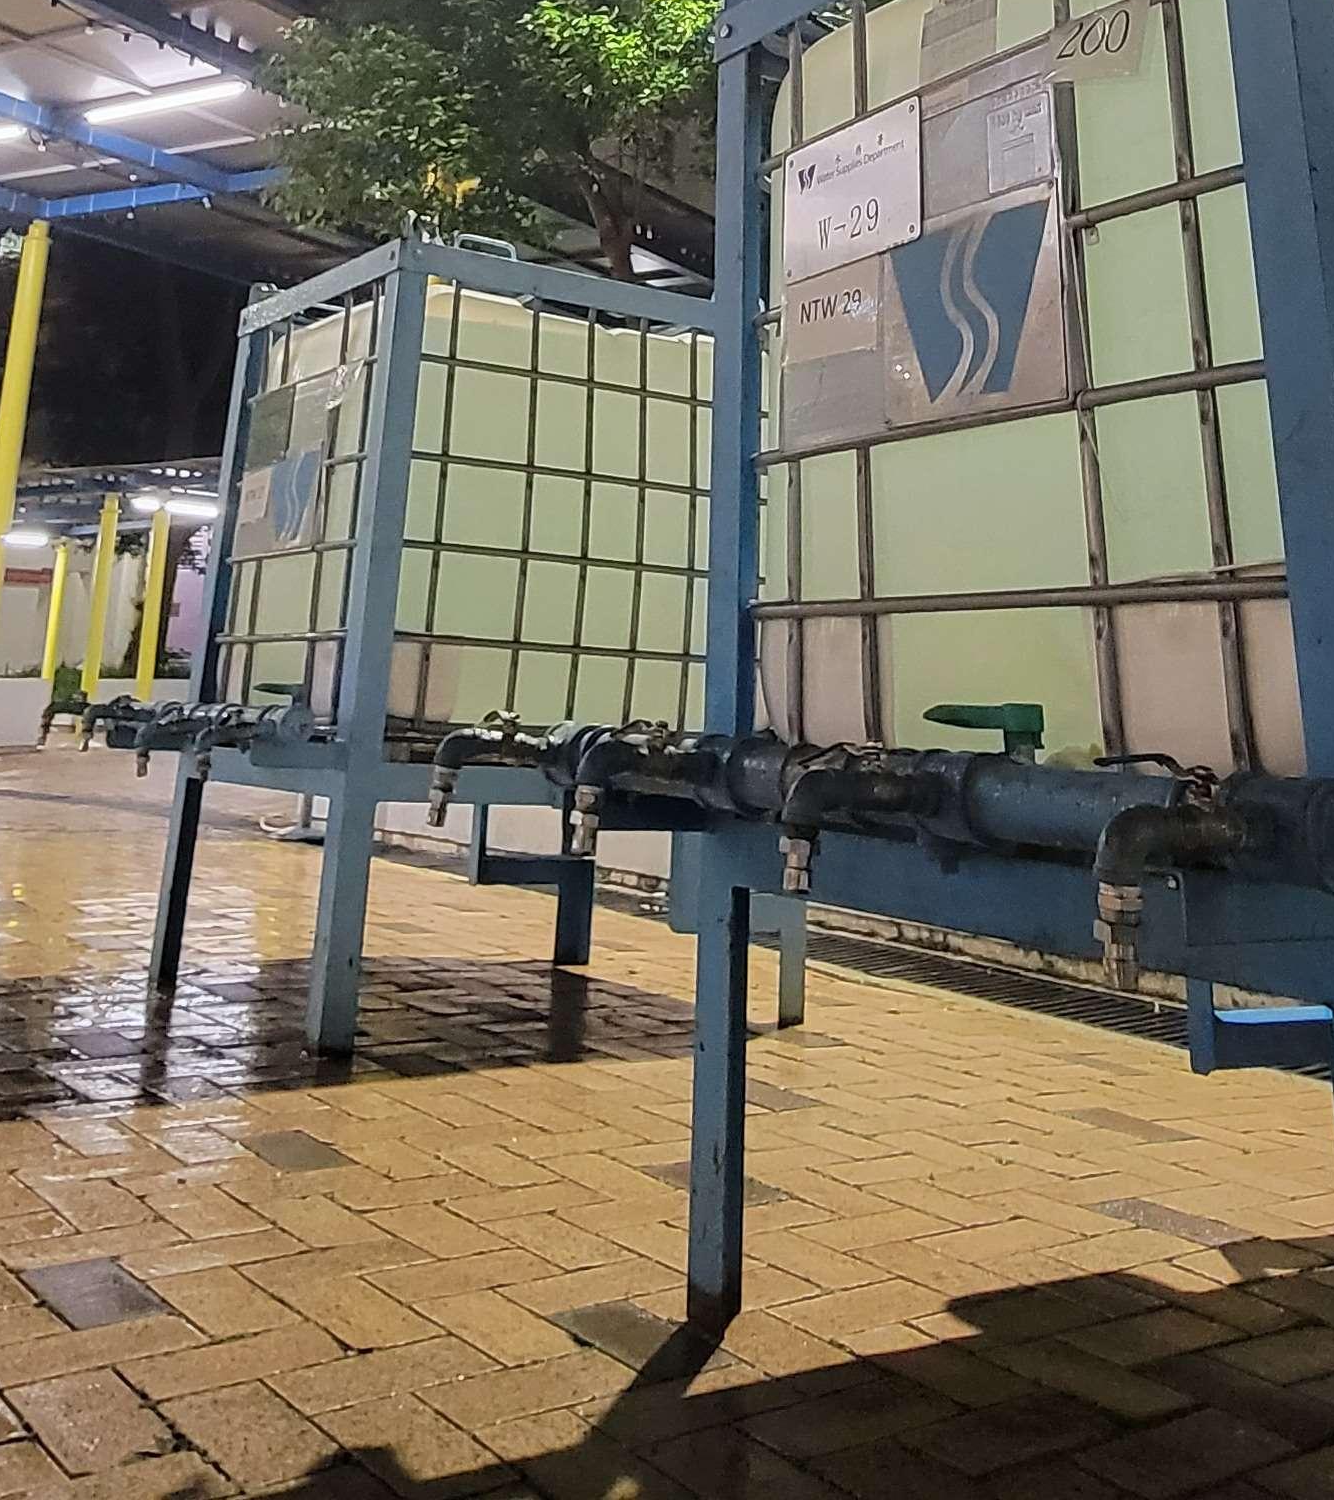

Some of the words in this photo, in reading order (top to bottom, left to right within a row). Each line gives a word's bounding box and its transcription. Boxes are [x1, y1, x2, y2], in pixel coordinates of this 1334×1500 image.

[1056, 9, 1130, 60] 200
[835, 158, 864, 178] Supplies
[863, 139, 905, 165] Department
[818, 198, 879, 250] W-29
[800, 294, 838, 324] NTW
[841, 288, 862, 315] 29
